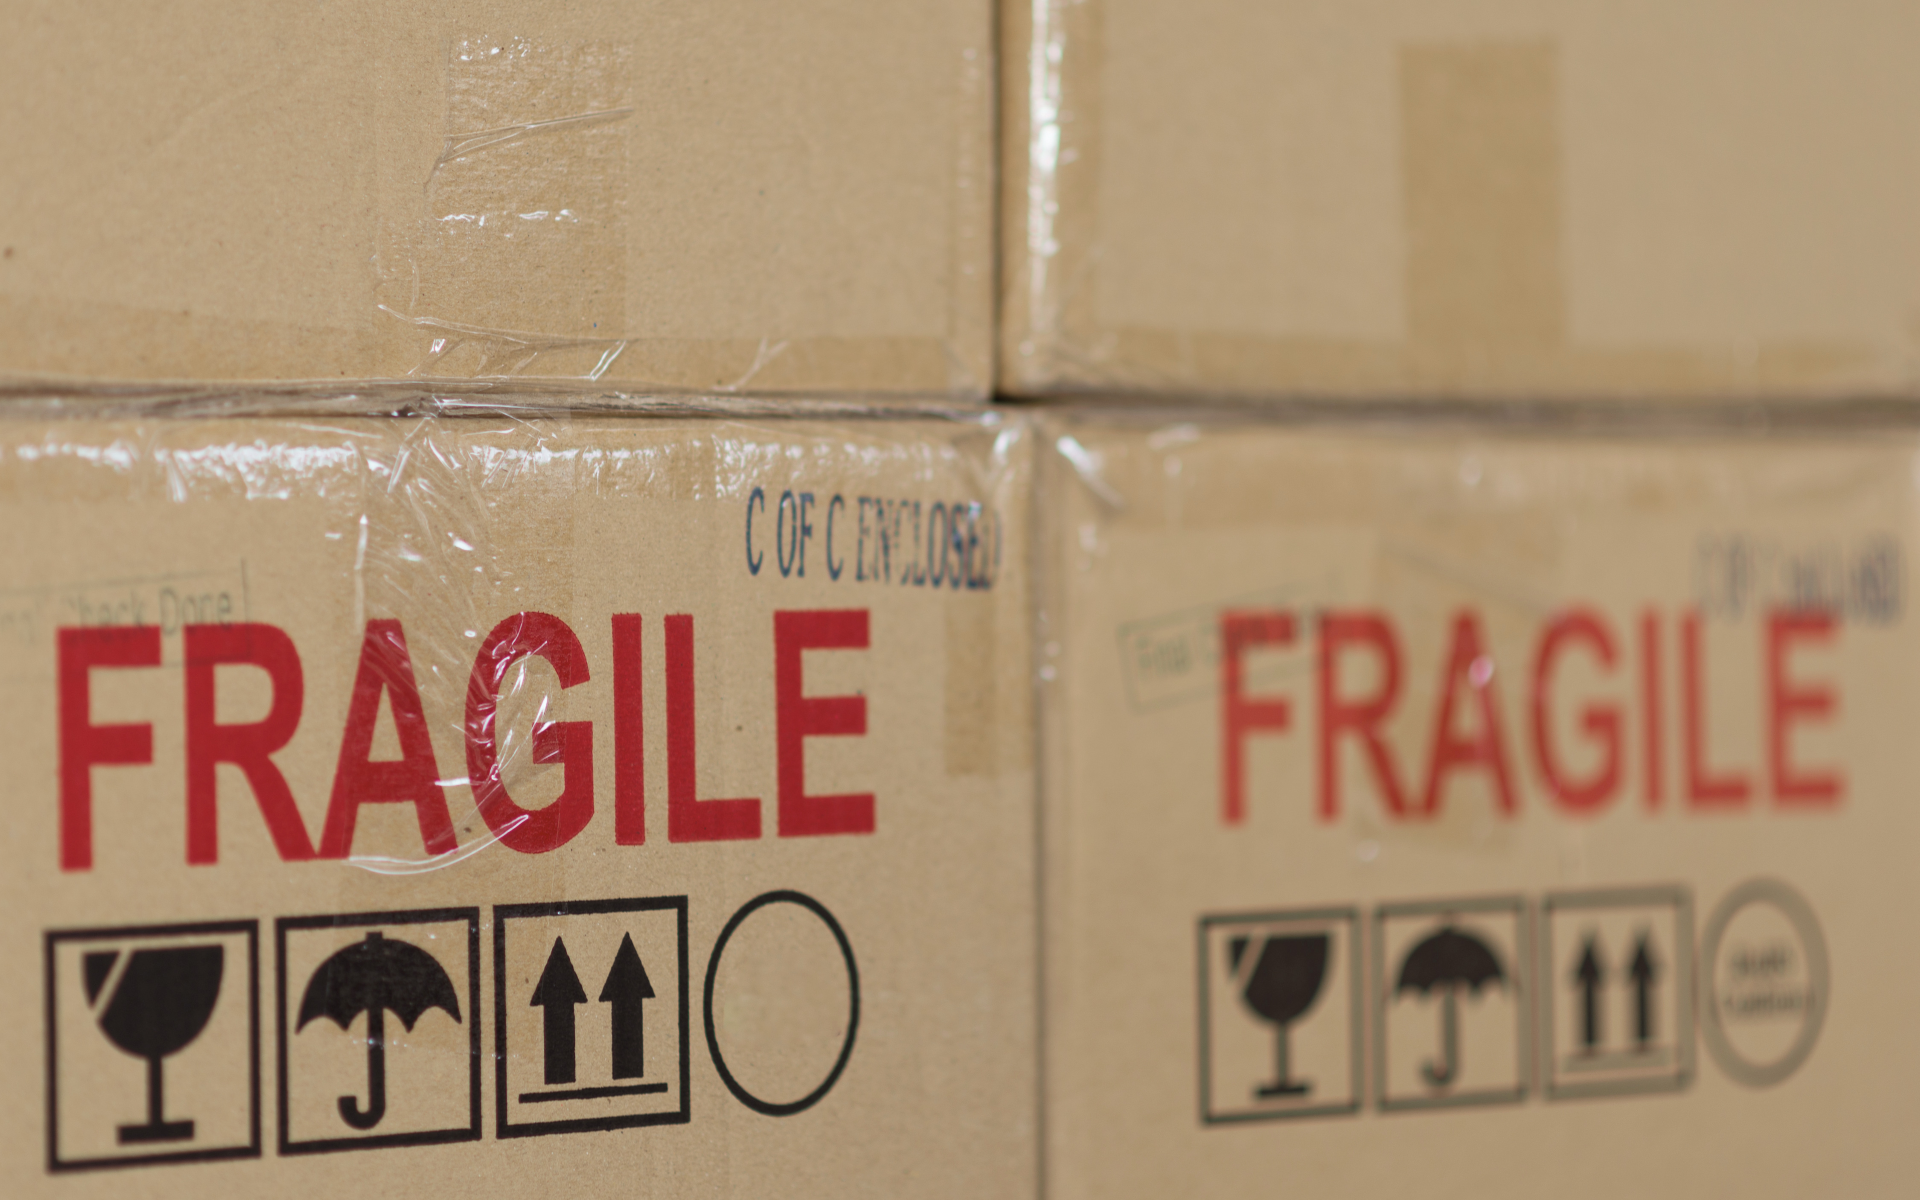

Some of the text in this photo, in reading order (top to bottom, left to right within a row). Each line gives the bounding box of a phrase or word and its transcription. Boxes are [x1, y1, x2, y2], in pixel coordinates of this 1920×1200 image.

[746, 486, 1002, 590] C OF C ENCLOSED
[57, 609, 877, 872] FRAGILE
[1219, 607, 1844, 824] FRAGILE
